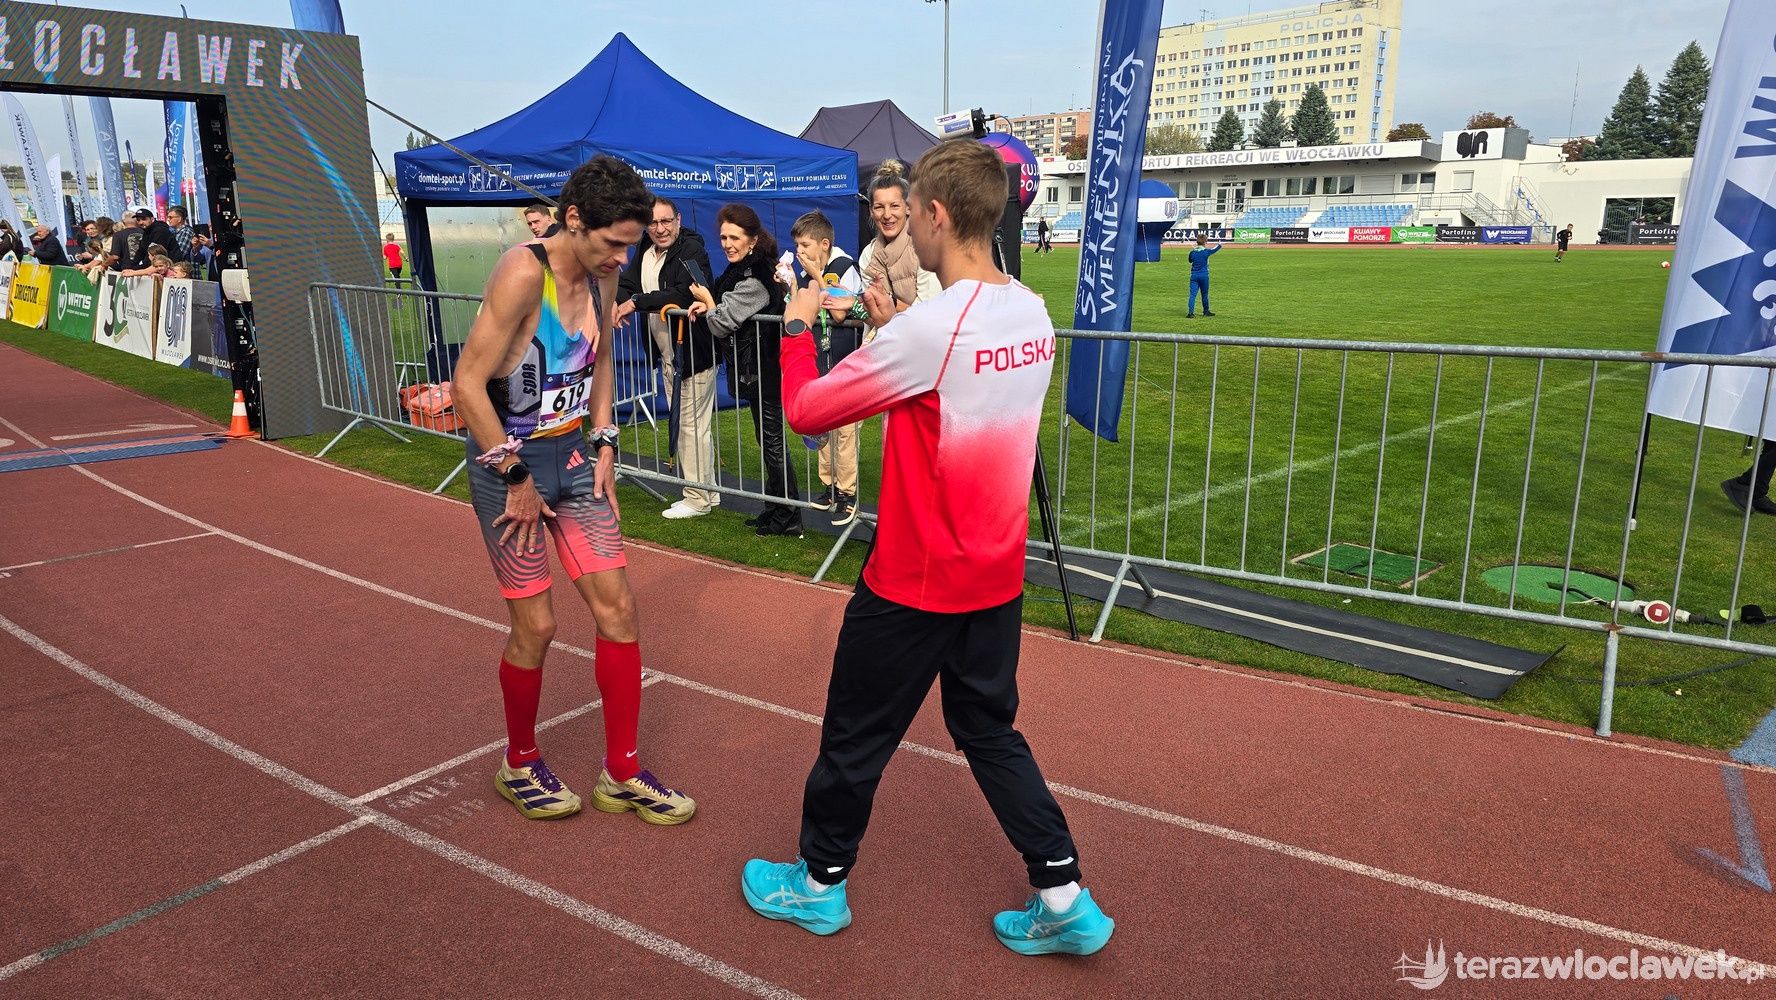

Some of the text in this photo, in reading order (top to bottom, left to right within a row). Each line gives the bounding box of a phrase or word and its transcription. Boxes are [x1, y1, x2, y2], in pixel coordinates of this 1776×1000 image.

[1280, 13, 1363, 33] POLICJA
[1185, 152, 1253, 166] REKREACJI
[1259, 151, 1281, 162] WE
[1286, 145, 1384, 161] WŁOCŁAWKU
[418, 172, 467, 185] domtel-sport.pl
[1081, 48, 1136, 324] SELENKA
[1100, 176, 1120, 314] WIENIEC
[68, 292, 92, 310] WATIS
[975, 336, 1056, 374] POLSKA
[521, 363, 538, 397] SOAR
[552, 382, 586, 413] 619
